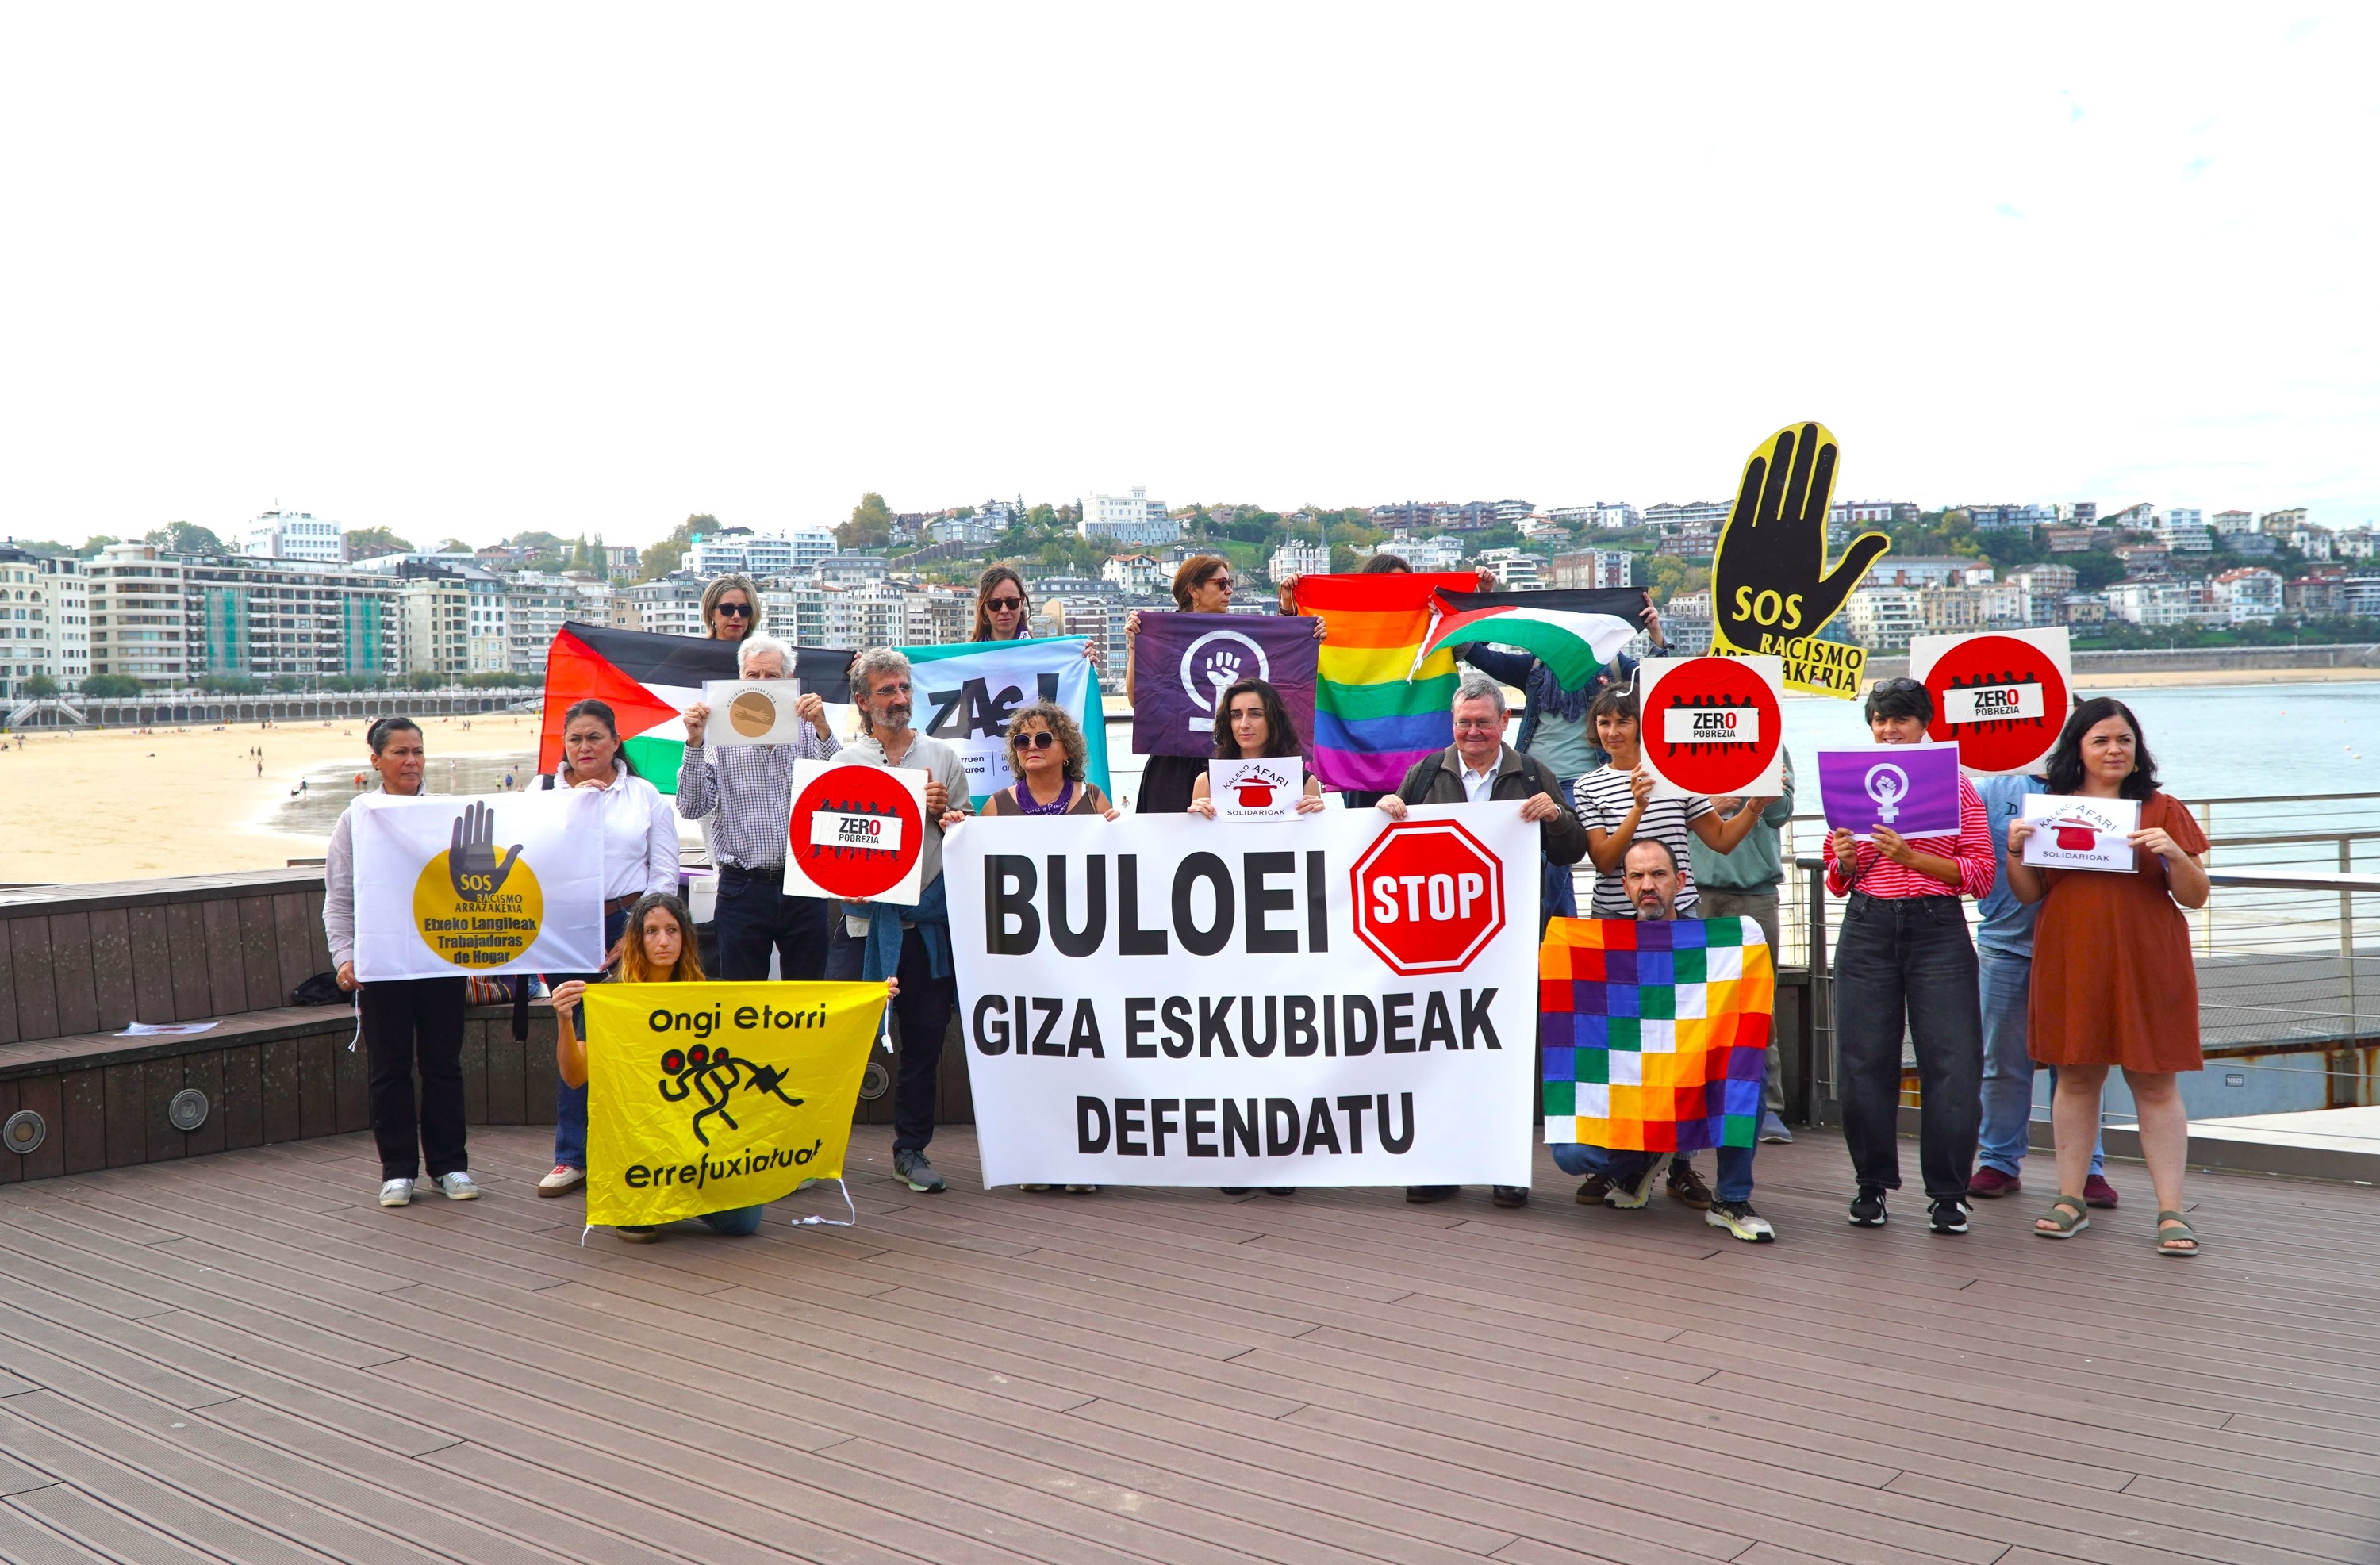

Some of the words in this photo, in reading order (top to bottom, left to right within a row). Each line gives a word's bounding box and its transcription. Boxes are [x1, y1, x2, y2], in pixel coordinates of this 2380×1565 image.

[1732, 585, 1803, 630] SOS
[1759, 632, 1863, 669] RACISMO
[1711, 646, 1856, 692] AKERIA
[1974, 689, 2020, 708] ZERO
[1975, 706, 2020, 716] POBREZIA
[1693, 712, 1737, 729] ZERO
[1693, 729, 1736, 738] POBREZIA
[1223, 765, 1250, 789] KALEKO
[1252, 765, 1289, 787] AFARI
[839, 817, 881, 835] ZERO
[2039, 803, 2072, 828] KALEKO
[2075, 804, 2117, 831] AFARI
[839, 834, 879, 844] POBREZIA
[2042, 851, 2110, 861] SOLIDARIOAK
[460, 874, 492, 892] SOS
[477, 893, 522, 904] RACISMO
[984, 850, 1329, 958] BULOEI
[1372, 873, 1484, 924] STOP
[455, 903, 523, 913] ARRAZAKERIA
[424, 917, 469, 932] Etxeko
[471, 916, 537, 932] Langileak
[437, 934, 523, 949] Trabajadoras
[454, 951, 470, 964] de
[473, 951, 510, 965] Hogar
[973, 994, 1105, 1059] GIZA
[1124, 988, 1503, 1059] ESKUBIDEAK
[1076, 1092, 1415, 1158] DEFENDATU
